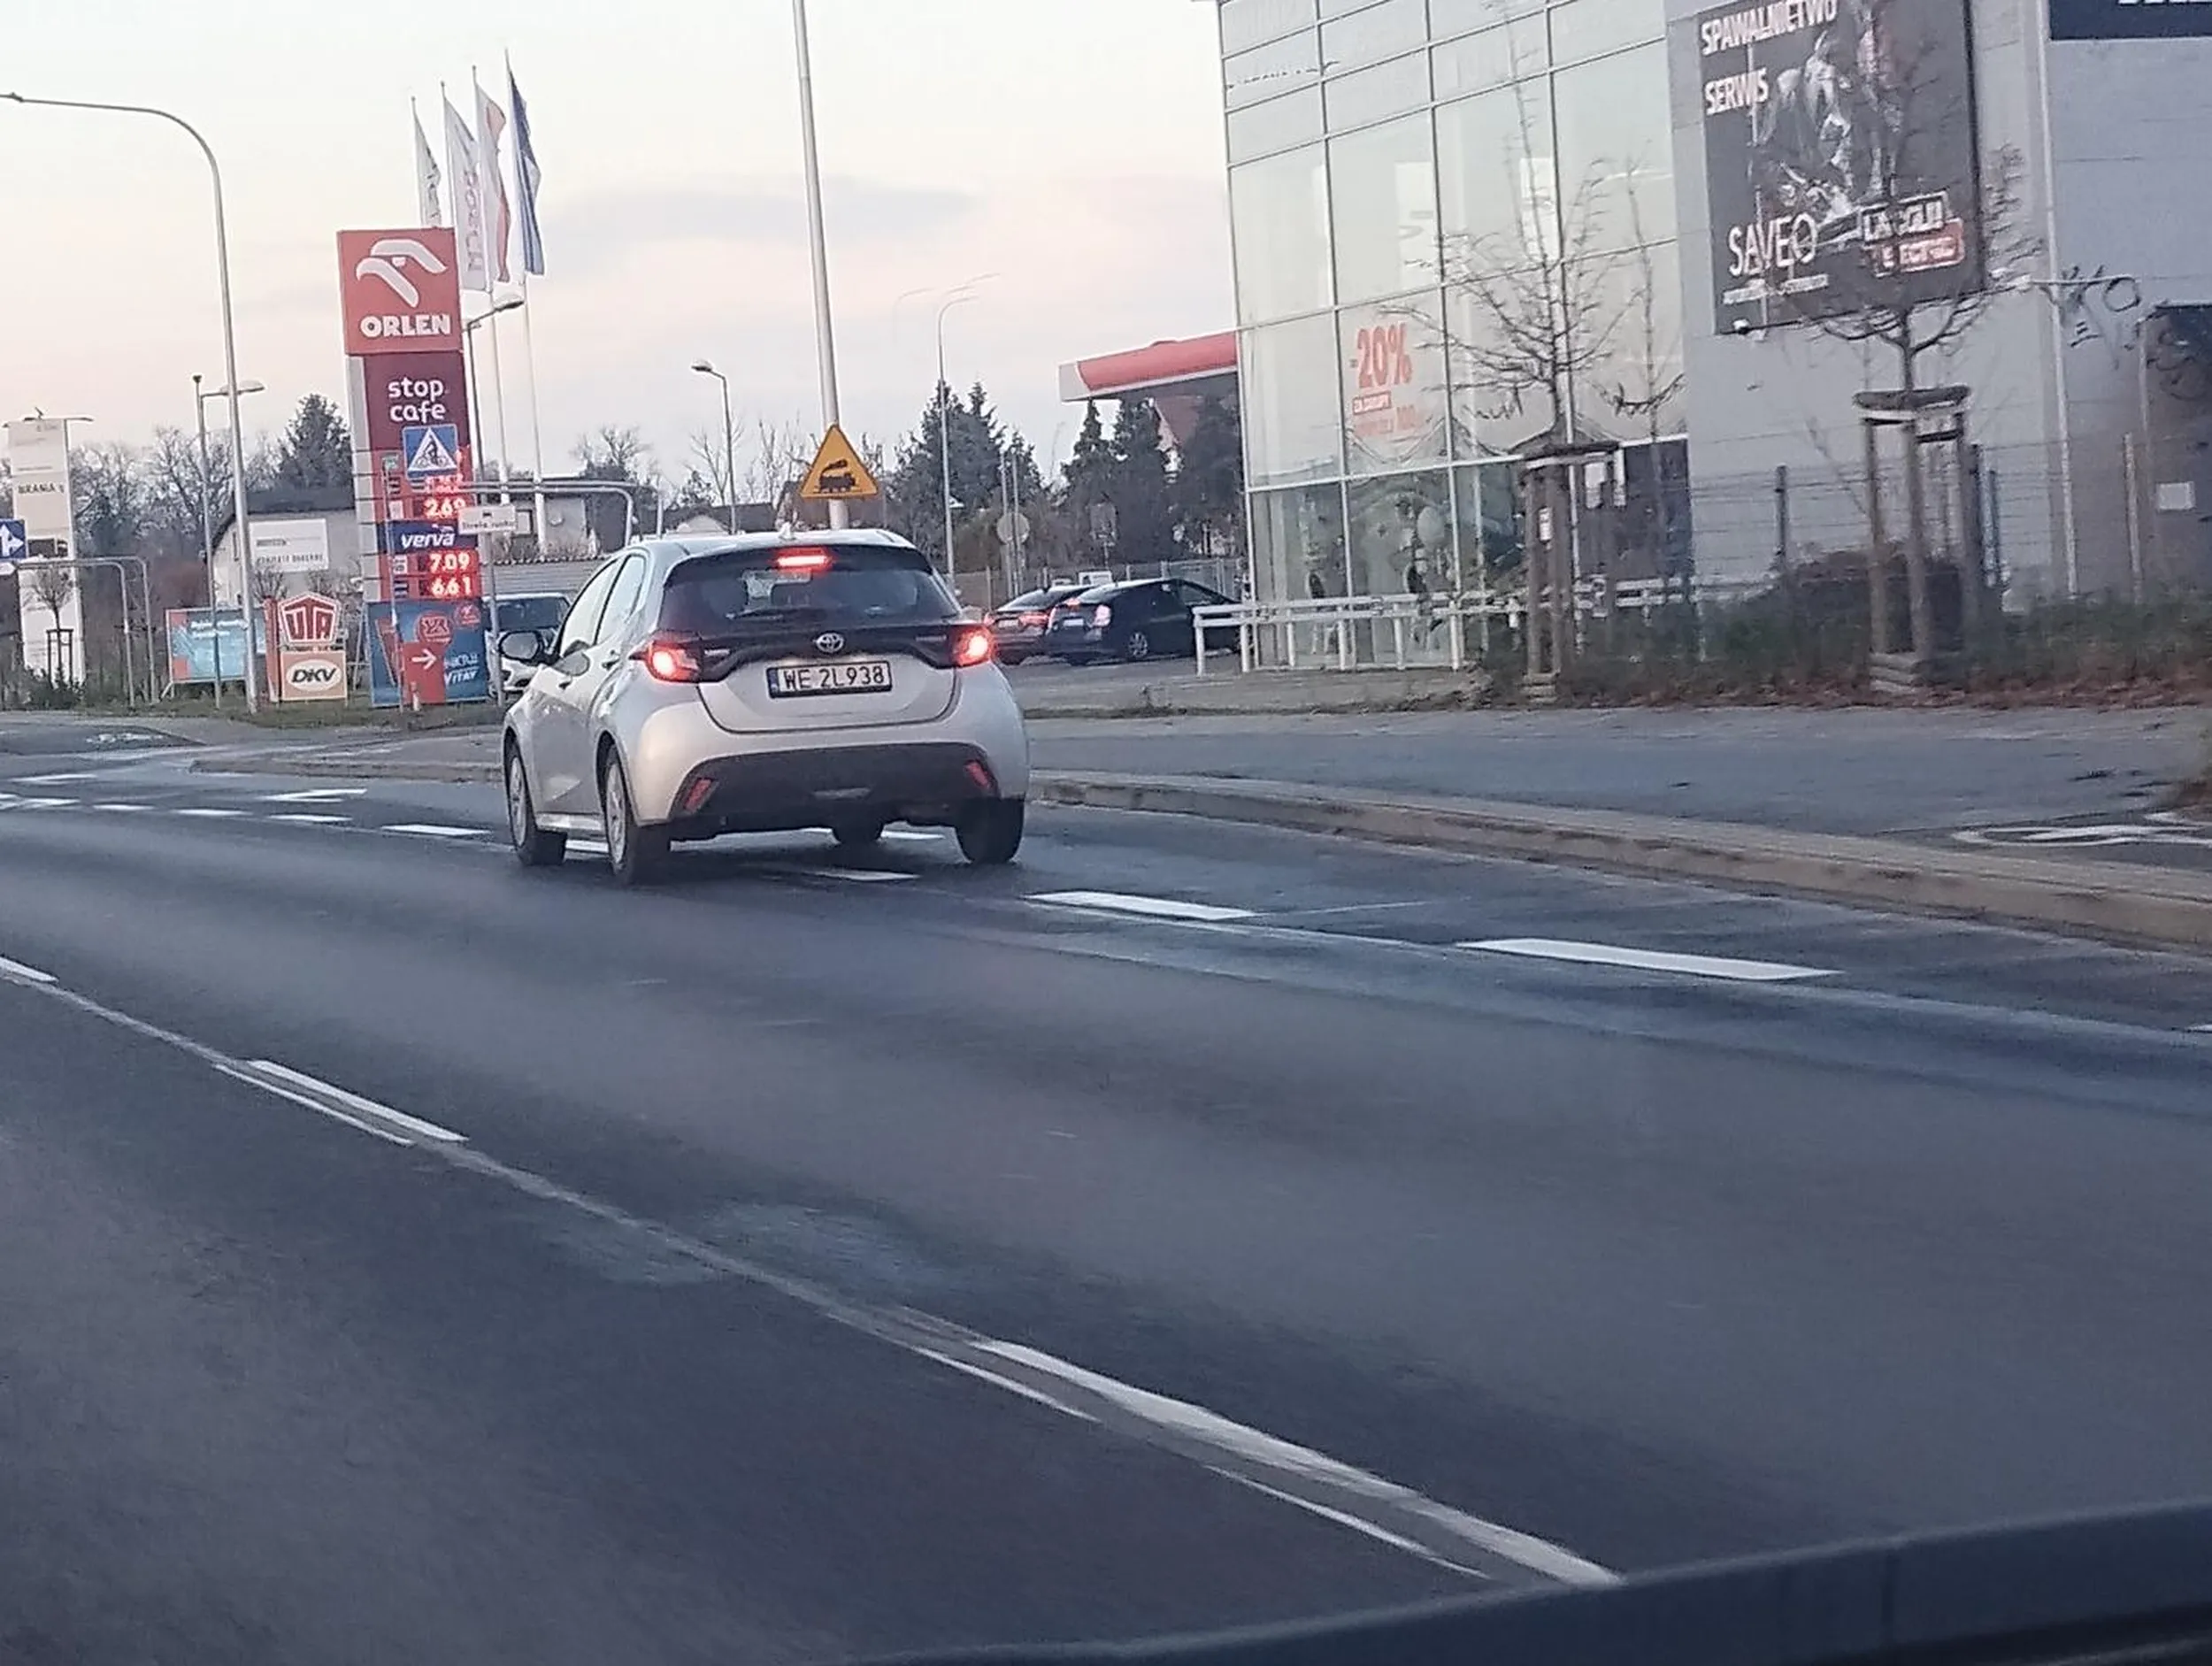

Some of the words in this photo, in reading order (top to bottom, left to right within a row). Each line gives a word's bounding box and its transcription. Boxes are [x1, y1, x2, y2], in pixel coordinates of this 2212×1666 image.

[1704, 66, 1770, 116] SERWIS
[359, 313, 451, 338] ORLEN
[1349, 321, 1413, 388] -20%
[388, 377, 444, 403] stop
[390, 401, 447, 424] cafe
[401, 533, 457, 549] verva
[283, 595, 335, 641] UTA
[291, 667, 337, 683] DKV
[784, 669, 811, 691] WE
[819, 665, 885, 689] 2L938
